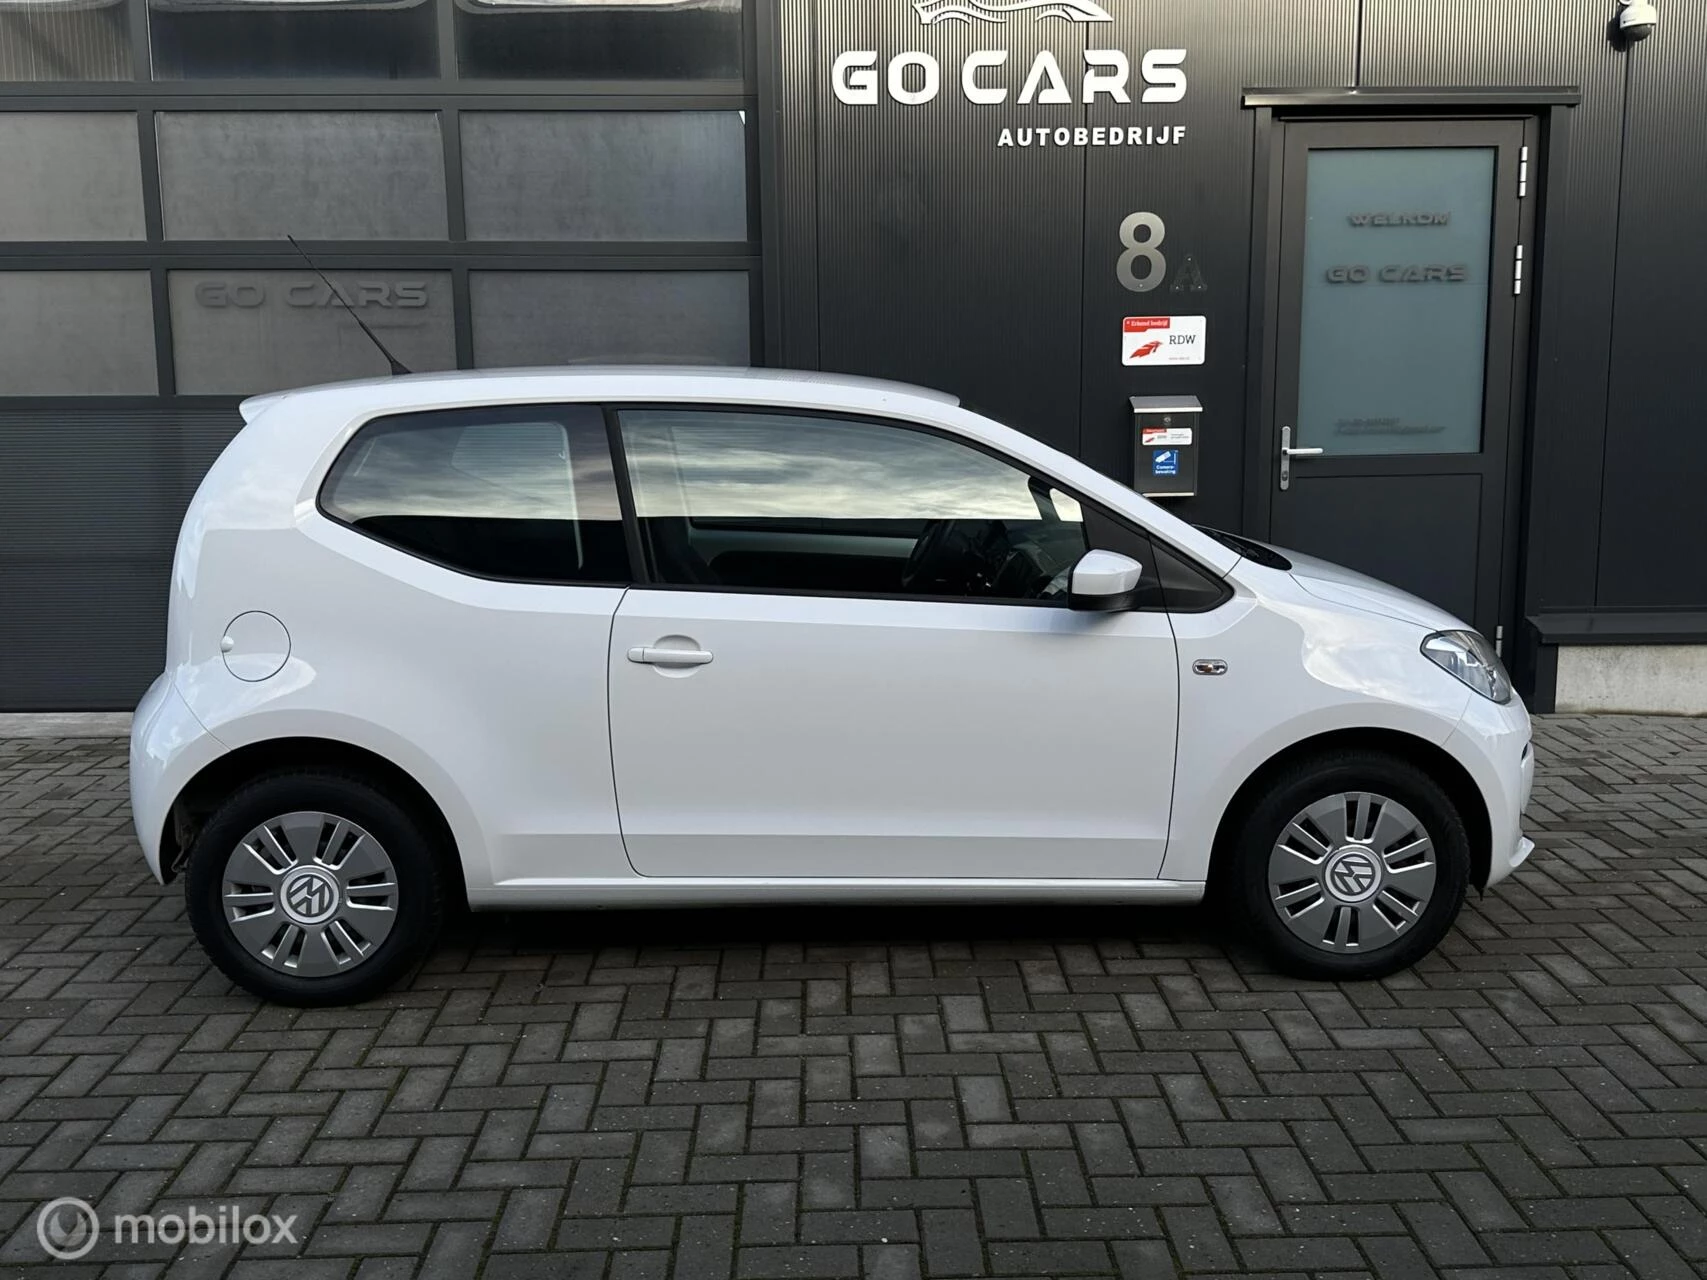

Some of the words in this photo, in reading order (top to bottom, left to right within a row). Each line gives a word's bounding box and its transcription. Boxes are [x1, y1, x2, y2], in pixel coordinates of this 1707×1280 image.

[832, 50, 940, 105] GO
[961, 49, 1187, 104] CARS
[997, 126, 1187, 147] AUTOBEDRIJF
[1348, 212, 1450, 226] WELKOM
[1326, 265, 1370, 284] GO
[1378, 264, 1467, 283] CARS
[195, 281, 266, 308] GO
[286, 280, 429, 308] CARS
[1169, 334, 1197, 345] RDW
